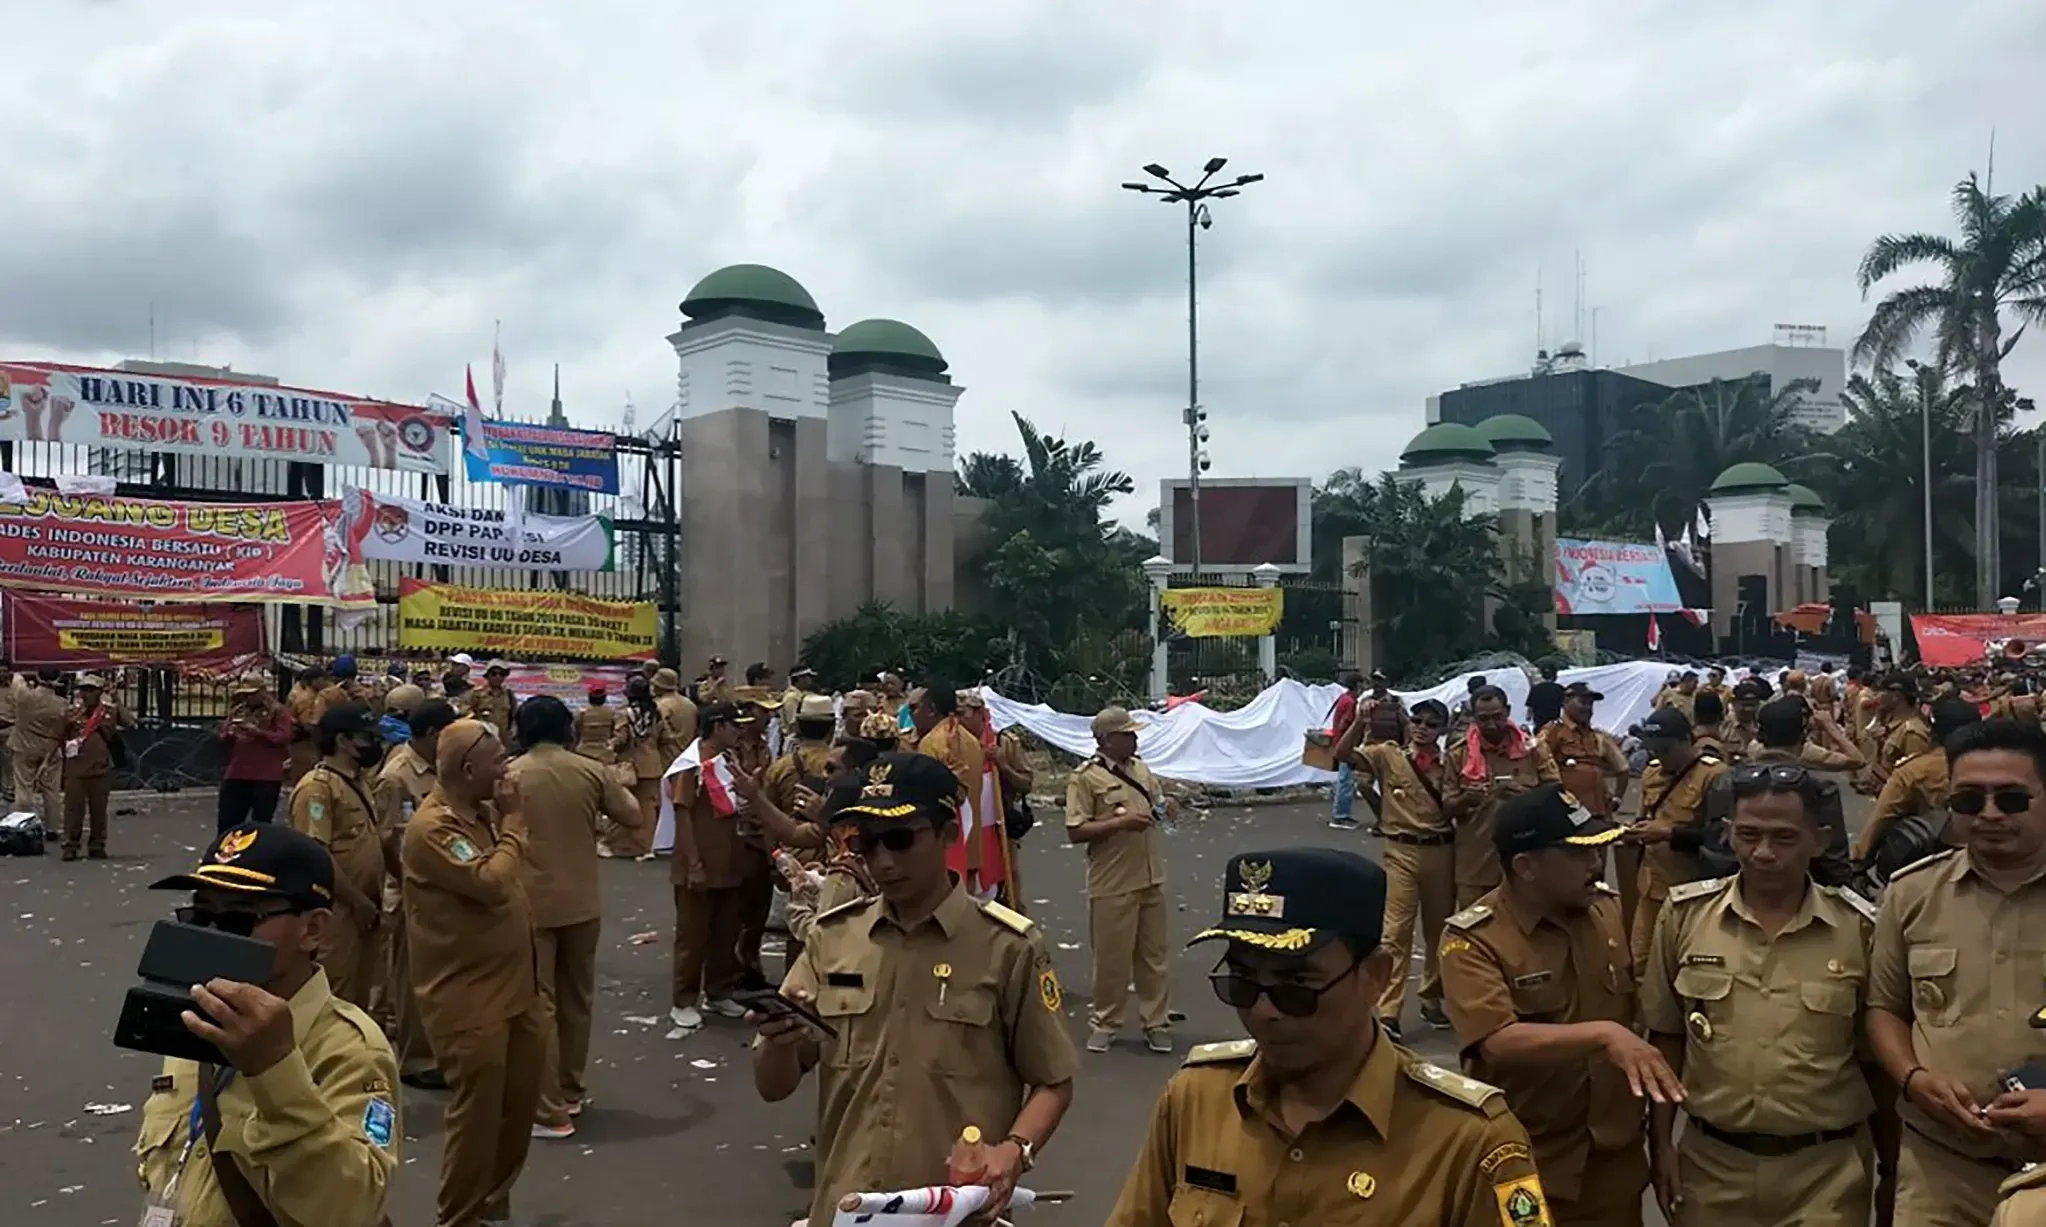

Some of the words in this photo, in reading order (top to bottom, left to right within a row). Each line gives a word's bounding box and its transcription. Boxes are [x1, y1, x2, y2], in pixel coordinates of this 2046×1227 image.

[80, 377, 160, 408] HARI
[172, 386, 217, 411] INI
[227, 391, 244, 416] 6
[252, 394, 350, 426] TAHUN
[99, 412, 203, 444] BESOK
[212, 420, 231, 447] 9
[239, 423, 338, 456] TAHUN
[424, 502, 466, 519] AKSI
[187, 507, 290, 543] DESA
[424, 520, 463, 536] DPP
[48, 528, 146, 550] INDONESIA
[151, 539, 221, 555] BERSATU
[424, 541, 485, 561] REVISI
[491, 549, 515, 562] UU
[519, 550, 562, 564] DESA
[27, 545, 121, 564] KABUPATEN
[127, 553, 235, 571] KARANGANYAR
